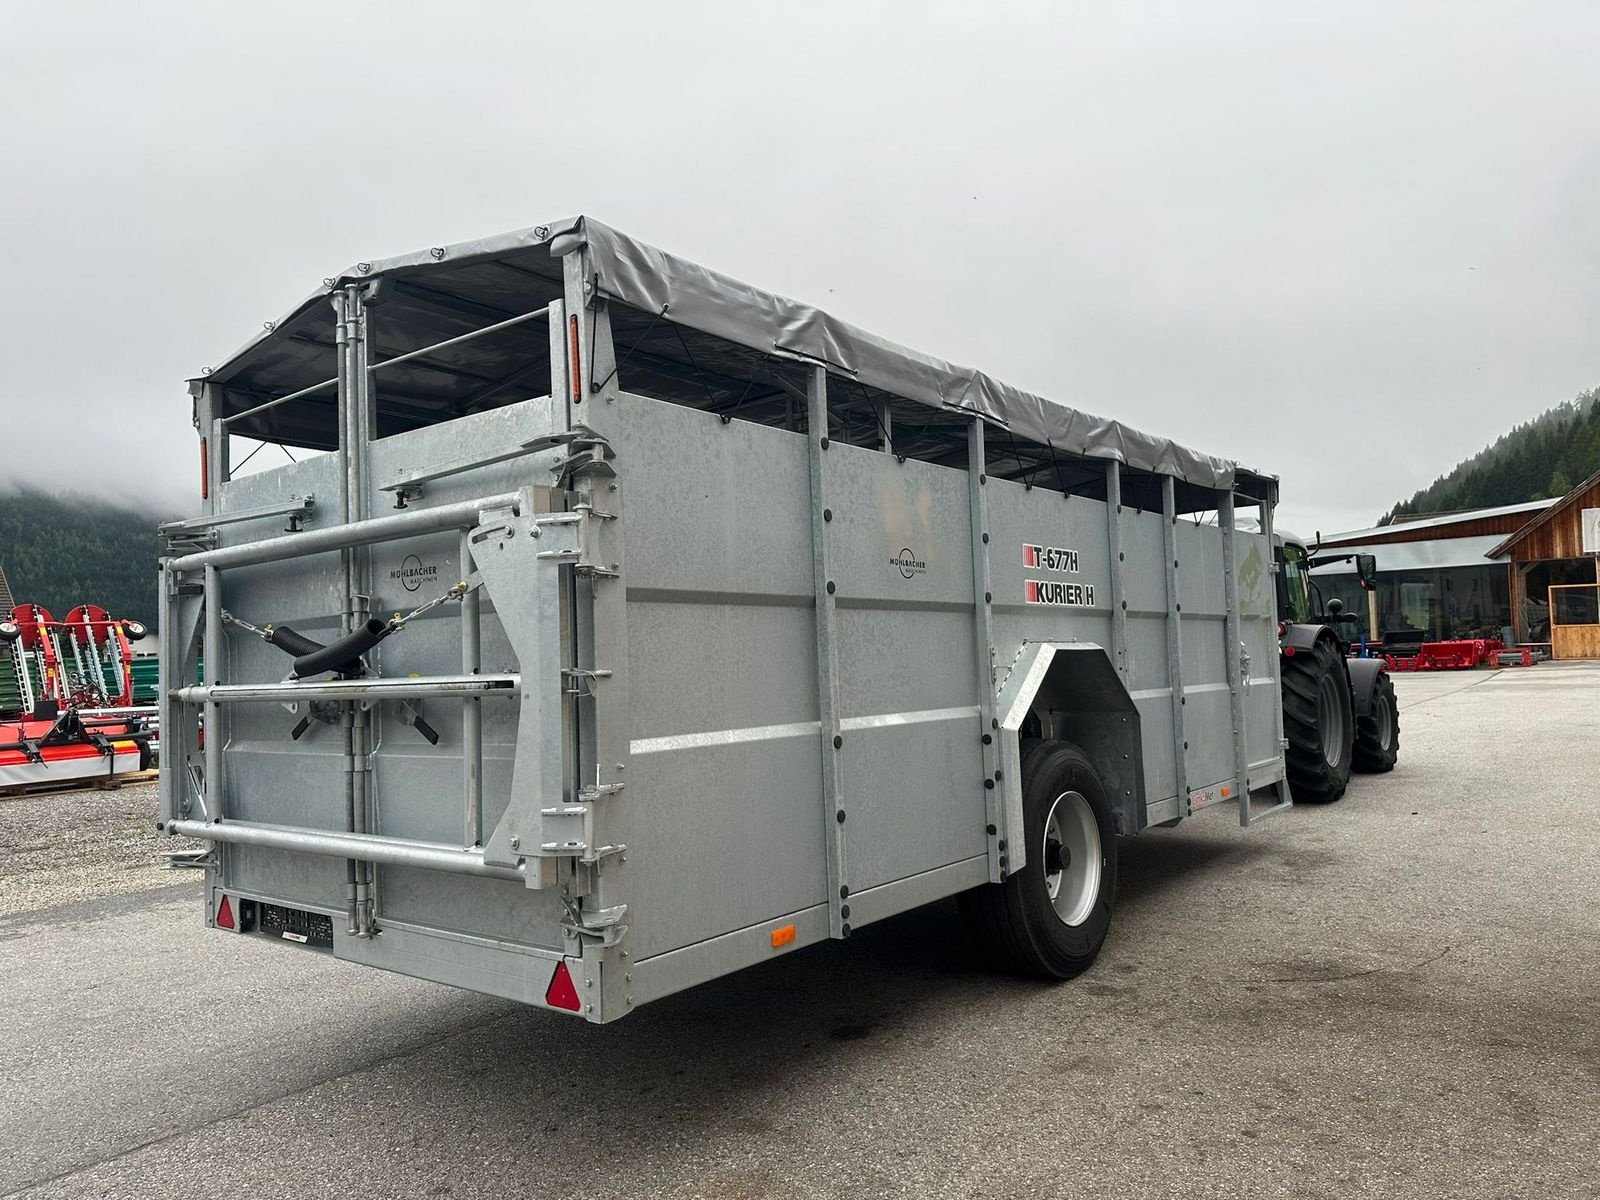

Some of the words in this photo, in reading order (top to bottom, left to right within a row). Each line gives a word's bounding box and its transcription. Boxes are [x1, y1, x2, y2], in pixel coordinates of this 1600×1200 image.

[1034, 546, 1079, 572] T-677H
[1035, 581, 1083, 605] KURIER
[1085, 585, 1095, 606] H
